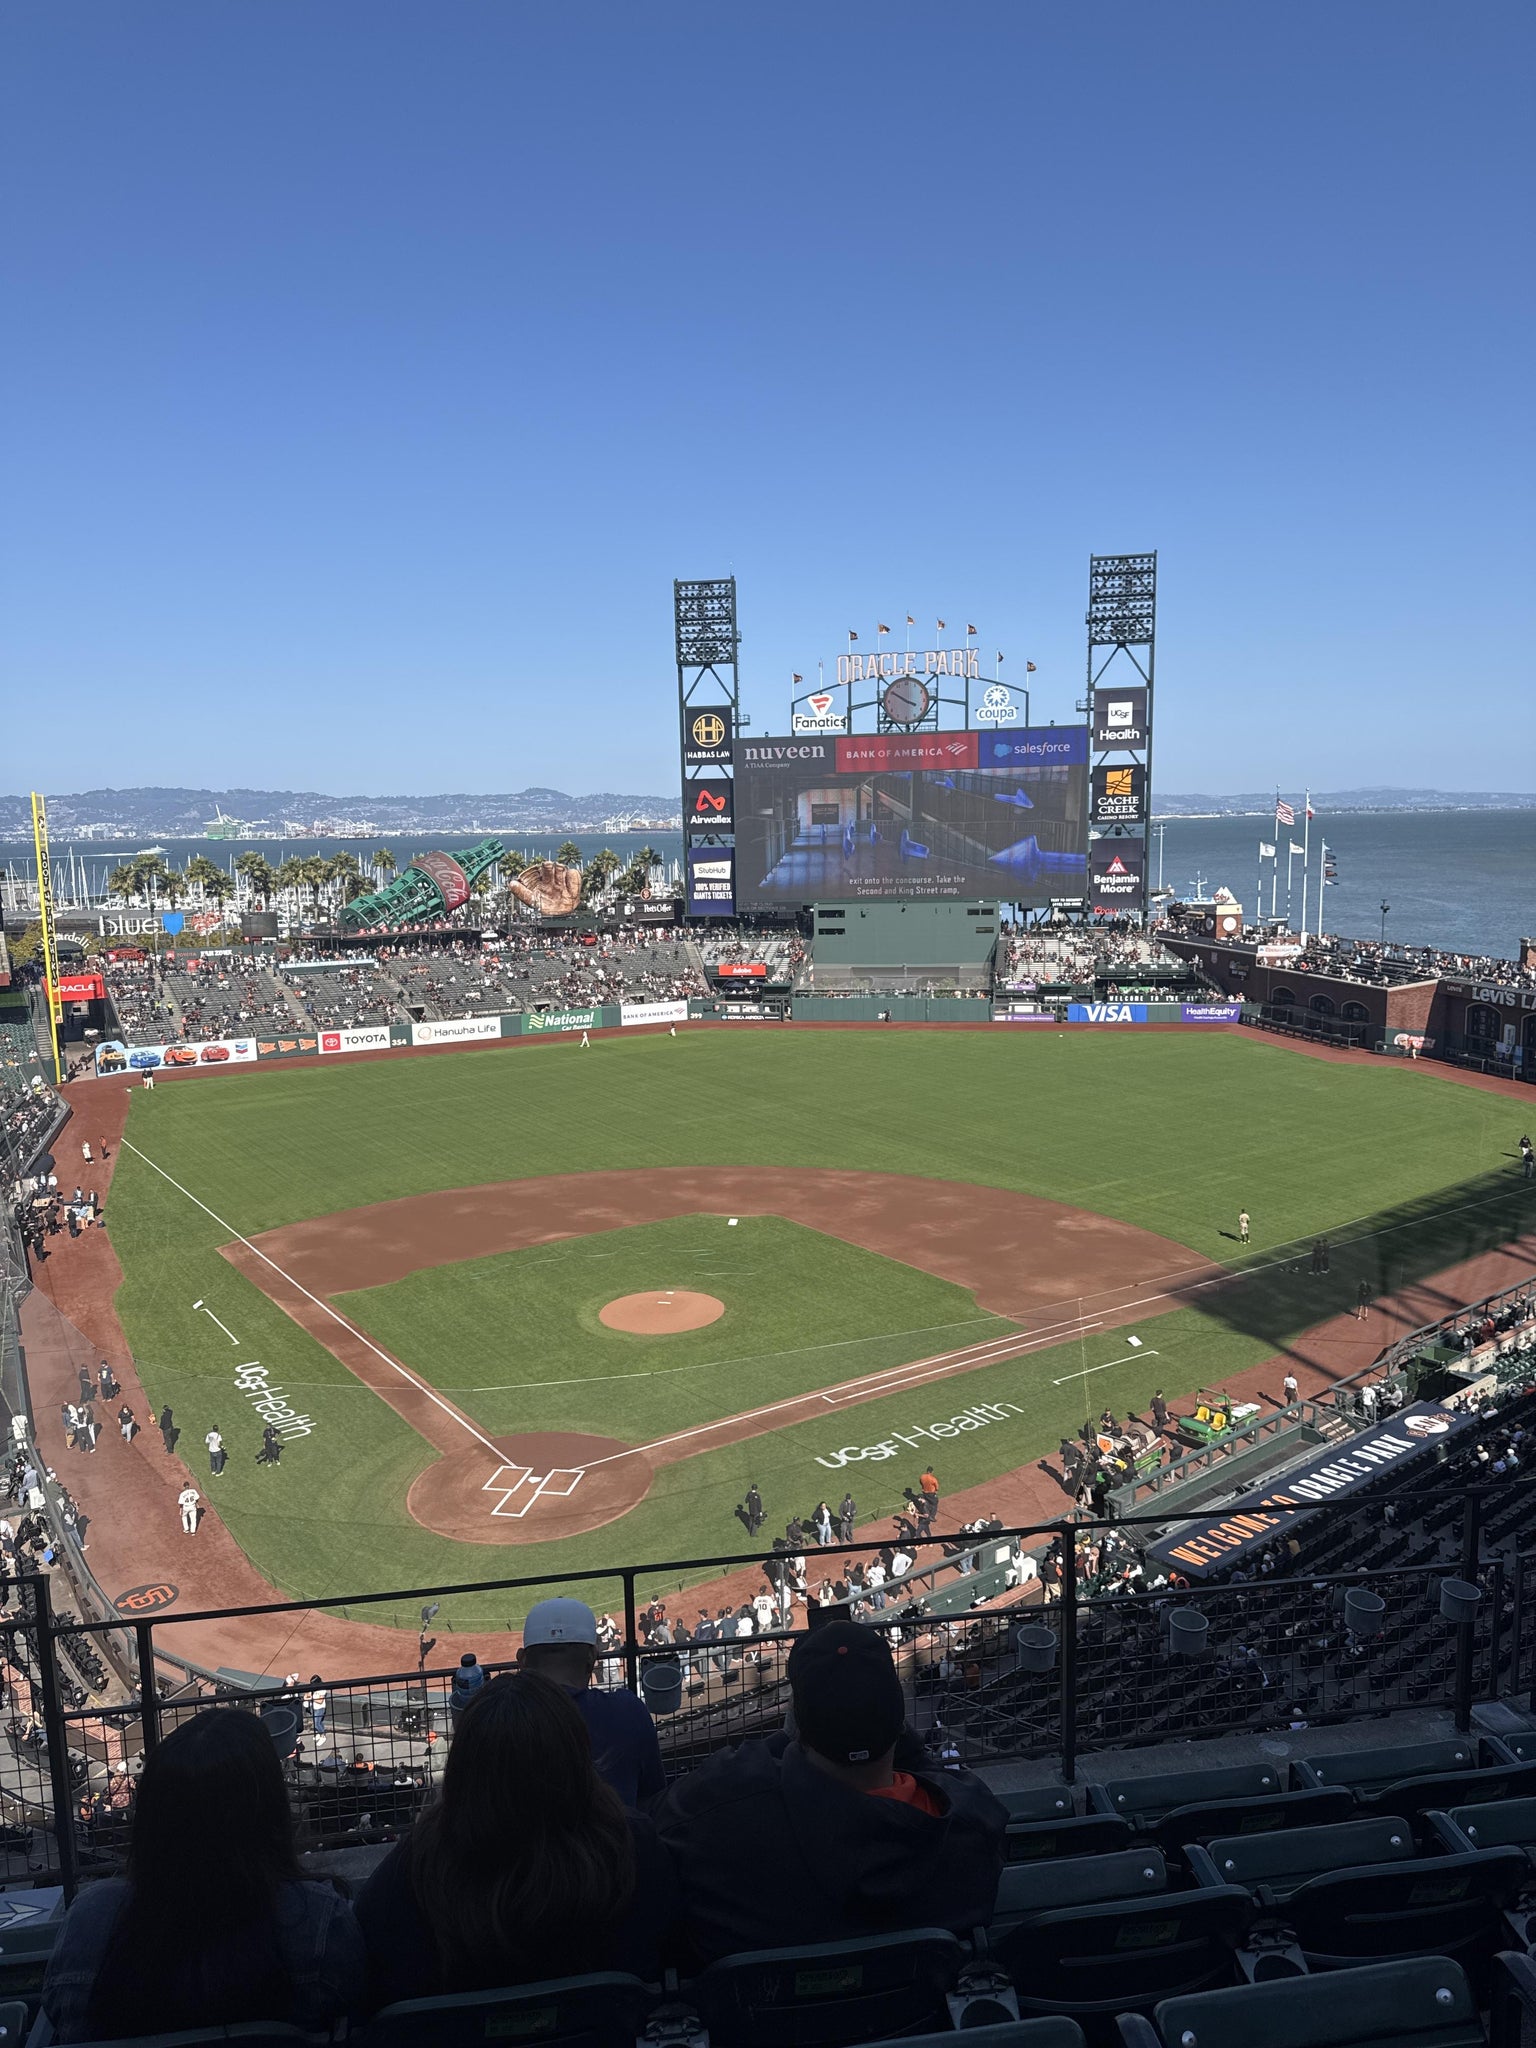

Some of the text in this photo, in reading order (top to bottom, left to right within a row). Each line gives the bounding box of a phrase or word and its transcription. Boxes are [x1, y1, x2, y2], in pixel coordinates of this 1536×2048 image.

[836, 648, 980, 685] ORACLE PARK
[979, 707, 1015, 721] coupa
[1110, 709, 1130, 719] UCSF
[795, 716, 847, 729] Fanatics
[1099, 728, 1140, 740] Health
[744, 745, 826, 760] nuveen
[846, 748, 943, 759] BANK OF AMERICA
[1014, 742, 1071, 755] salesforce
[687, 750, 730, 759] HABBAS LAW
[1097, 796, 1139, 805] CACHE
[1098, 805, 1138, 814] CREEK
[690, 815, 732, 824] Airwallex
[849, 877, 862, 885] exit
[895, 877, 934, 885] concourse.
[936, 876, 952, 884] Take
[953, 875, 965, 883] the
[1093, 874, 1140, 885] Benjamin
[856, 886, 960, 896] Second and King Street ramp,
[1100, 885, 1133, 893] Moore
[693, 891, 732, 900] GIANTS TICKETS
[99, 914, 159, 937] blue
[1082, 1005, 1133, 1022] VISA
[1186, 1007, 1235, 1016] HealthEquity
[544, 1011, 595, 1027] National
[434, 1024, 497, 1037] Hanwha Life
[344, 1034, 387, 1045] TOYOTA
[391, 1038, 407, 1046] 354
[233, 1361, 317, 1441] UCSF Health
[814, 1402, 1025, 1468] UCSF Health
[1168, 1511, 1281, 1566] WELCOME
[1288, 1458, 1373, 1500] ORACLE
[1351, 1433, 1416, 1464] PARK
[758, 1603, 768, 1611] 10
